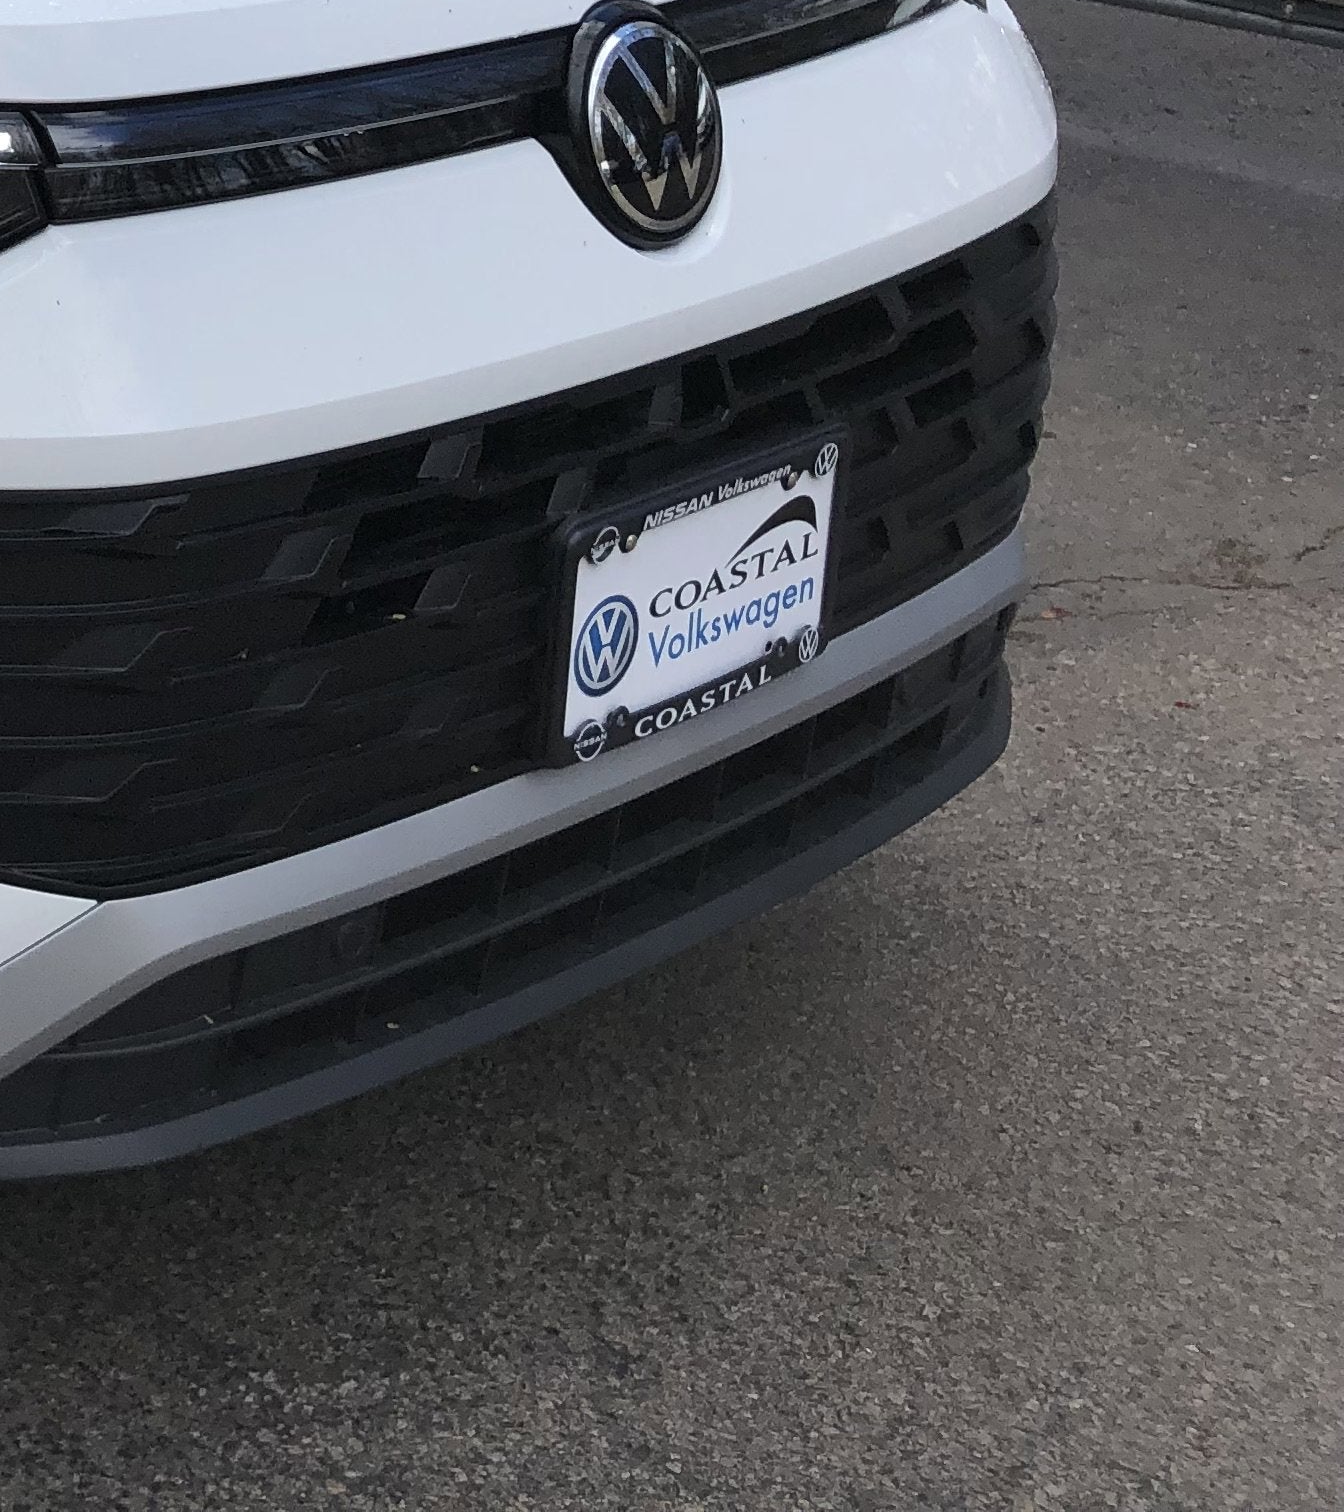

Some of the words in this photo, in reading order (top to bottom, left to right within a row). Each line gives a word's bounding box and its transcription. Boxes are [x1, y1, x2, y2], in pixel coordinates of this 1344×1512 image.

[644, 491, 714, 531] NISSAN
[718, 464, 792, 501] Volkswagen
[649, 531, 819, 618] COASTAL
[647, 576, 814, 668] Volkswagen
[634, 664, 772, 738] COASTAL
